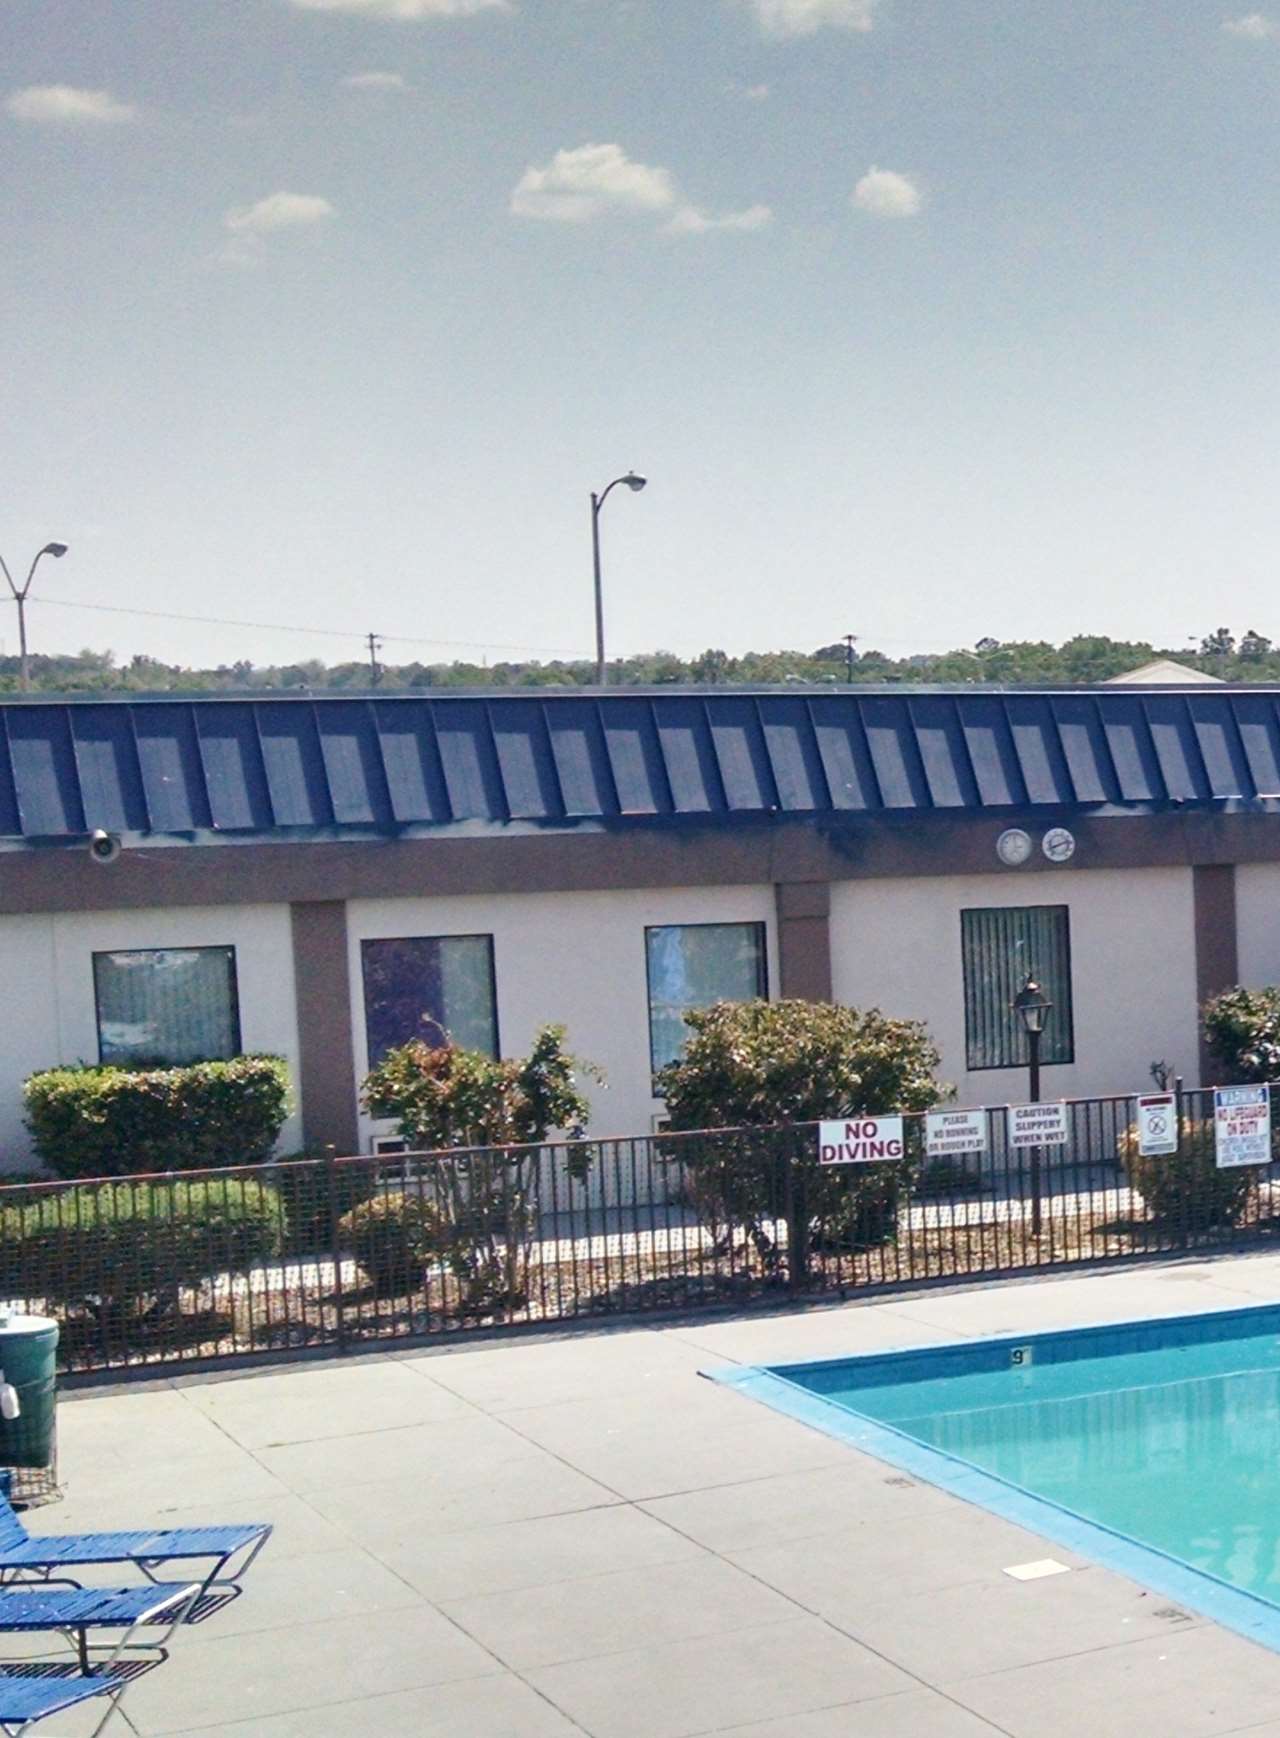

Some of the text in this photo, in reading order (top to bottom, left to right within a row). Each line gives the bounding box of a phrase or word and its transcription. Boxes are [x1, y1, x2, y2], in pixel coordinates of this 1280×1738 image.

[1016, 1107, 1060, 1118] CAUTION
[943, 1114, 968, 1125] PLEASE
[1015, 1119, 1062, 1131] SLIPPERY
[844, 1121, 878, 1140] NO
[934, 1129, 944, 1139] NO
[1227, 1120, 1259, 1136] ON DUTY
[1012, 1131, 1065, 1144] WHEN WET
[967, 1139, 985, 1149] PLAY
[821, 1139, 902, 1162] DIVING
[1012, 1349, 1024, 1365] 9
